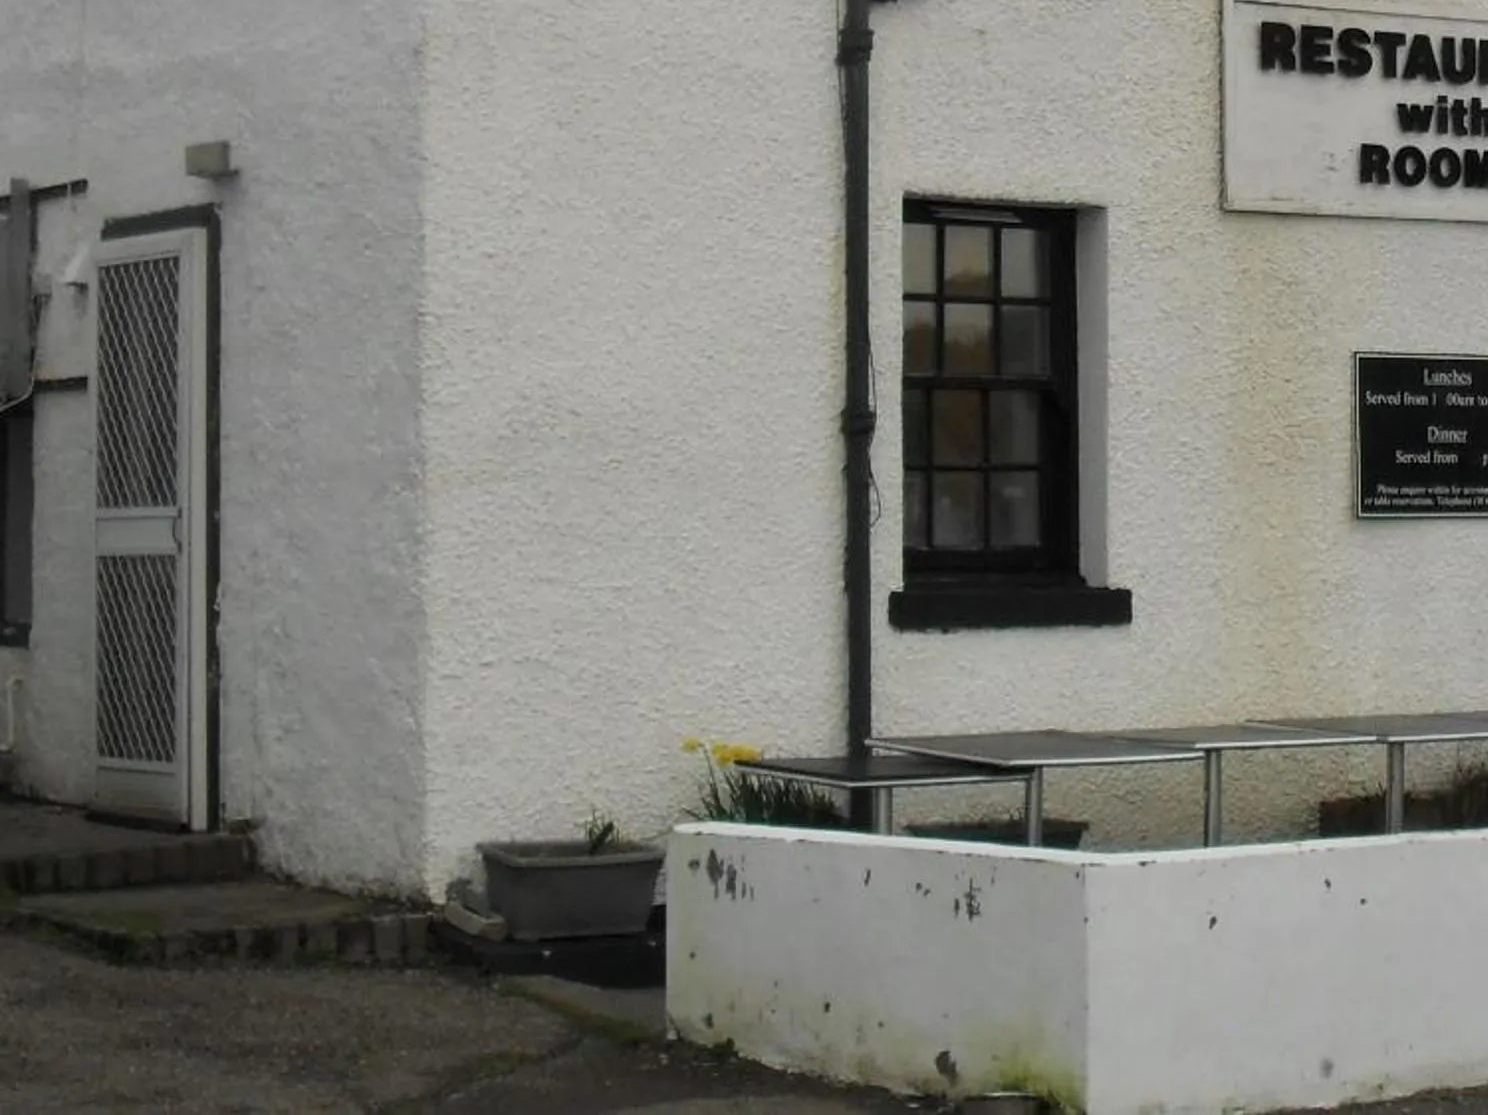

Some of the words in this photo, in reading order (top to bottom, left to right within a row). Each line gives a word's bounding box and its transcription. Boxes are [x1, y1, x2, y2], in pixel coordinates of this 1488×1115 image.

[1423, 368, 1472, 386] Lunches
[1365, 391, 1400, 406] Served
[1403, 392, 1429, 406] from
[1478, 393, 1488, 406] to
[1427, 426, 1468, 443] Dinner
[1396, 450, 1430, 464] Served
[1433, 451, 1458, 464] from
